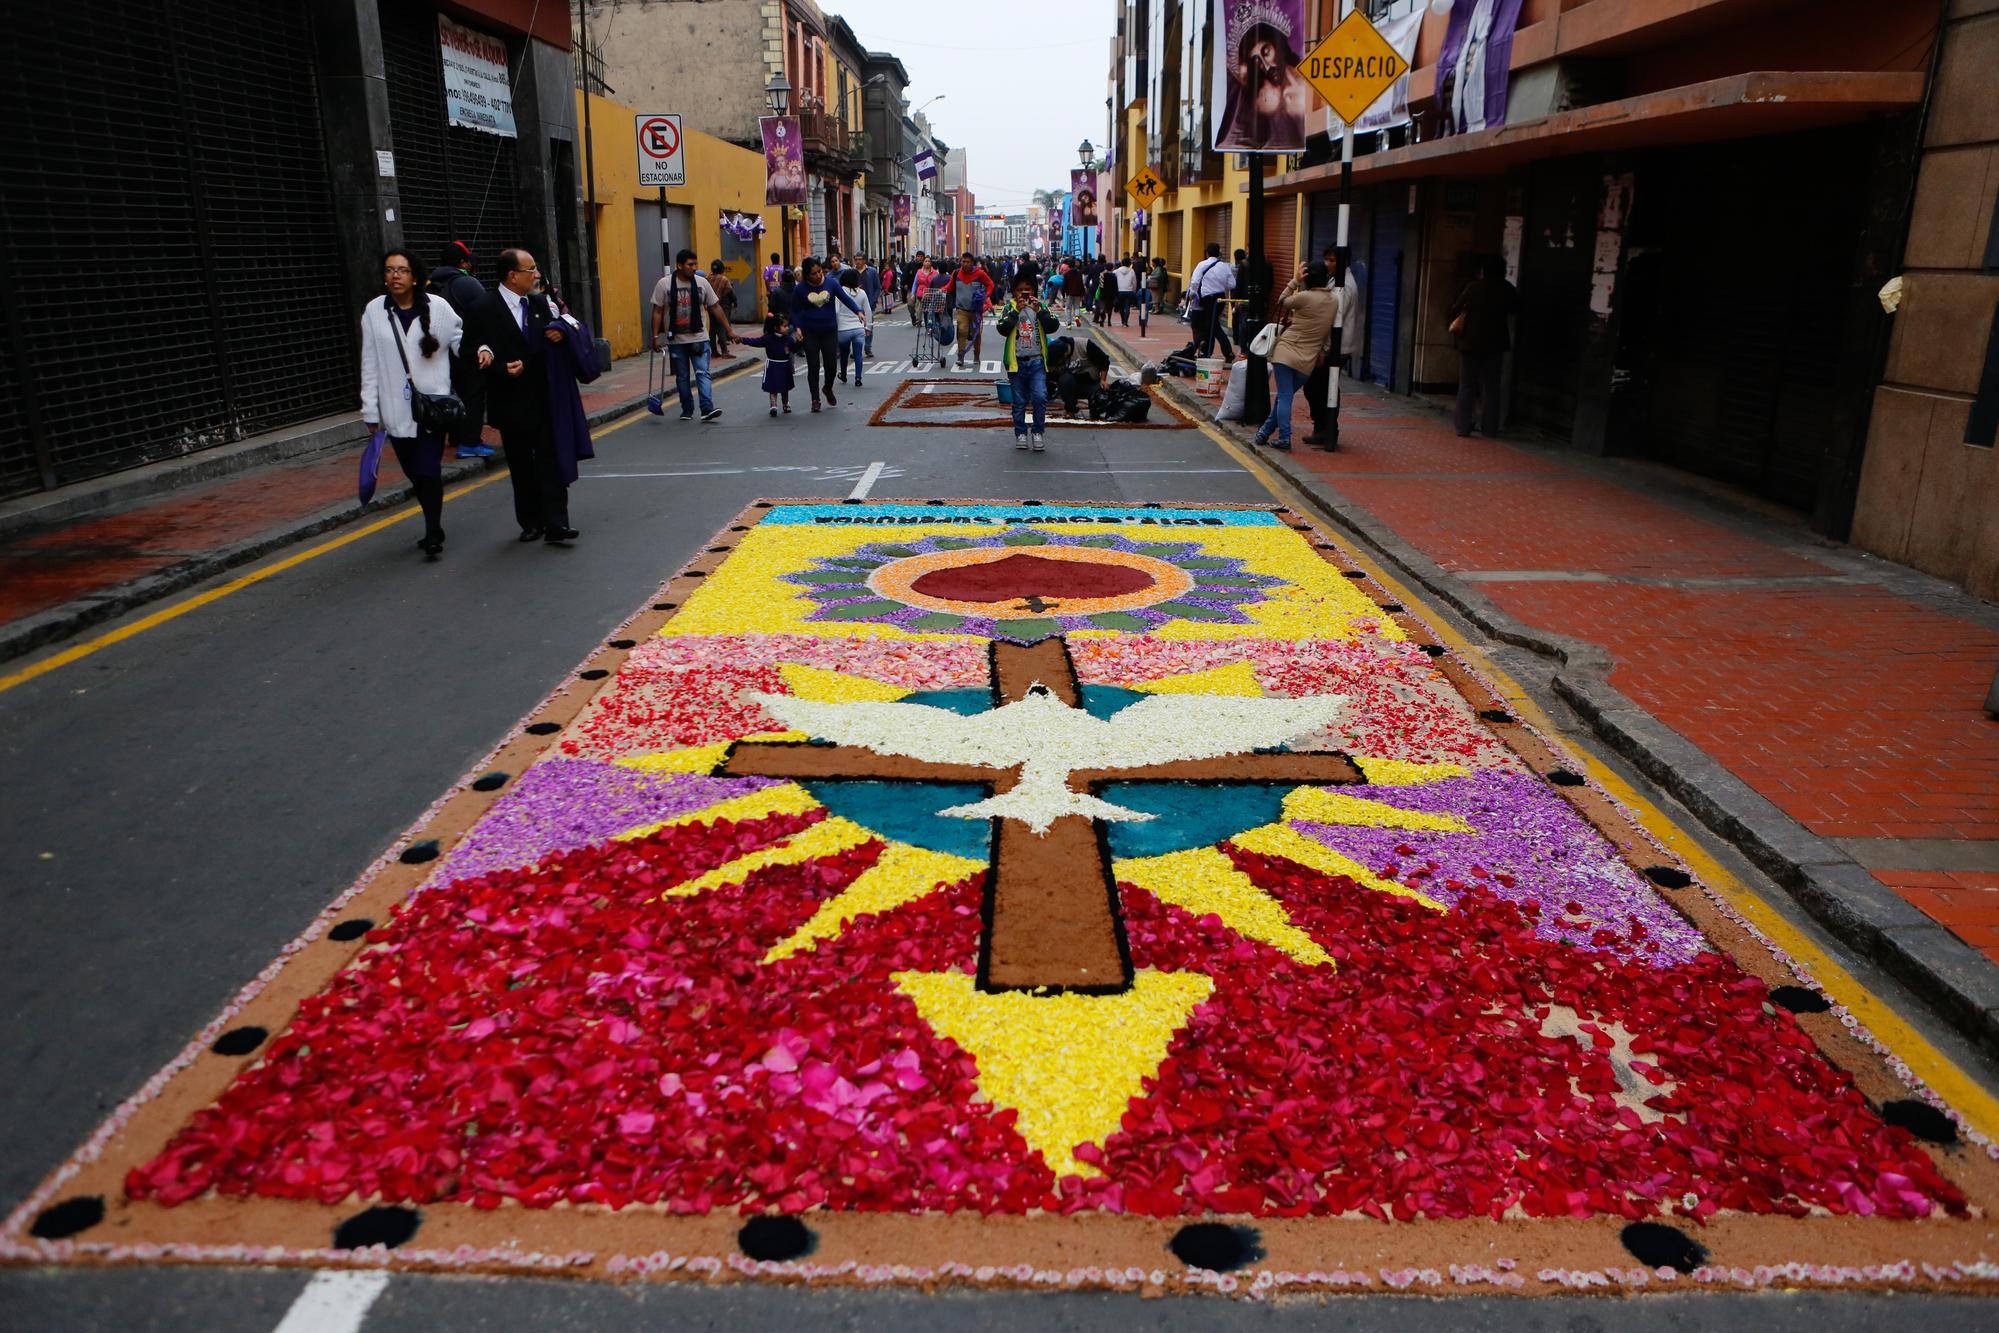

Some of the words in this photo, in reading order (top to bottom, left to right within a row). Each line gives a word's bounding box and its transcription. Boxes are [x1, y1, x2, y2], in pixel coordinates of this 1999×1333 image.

[1310, 56, 1396, 79] DESPACIO
[655, 161, 668, 170] NO
[641, 173, 682, 182] ESTACIONAR
[773, 271, 779, 282] 4
